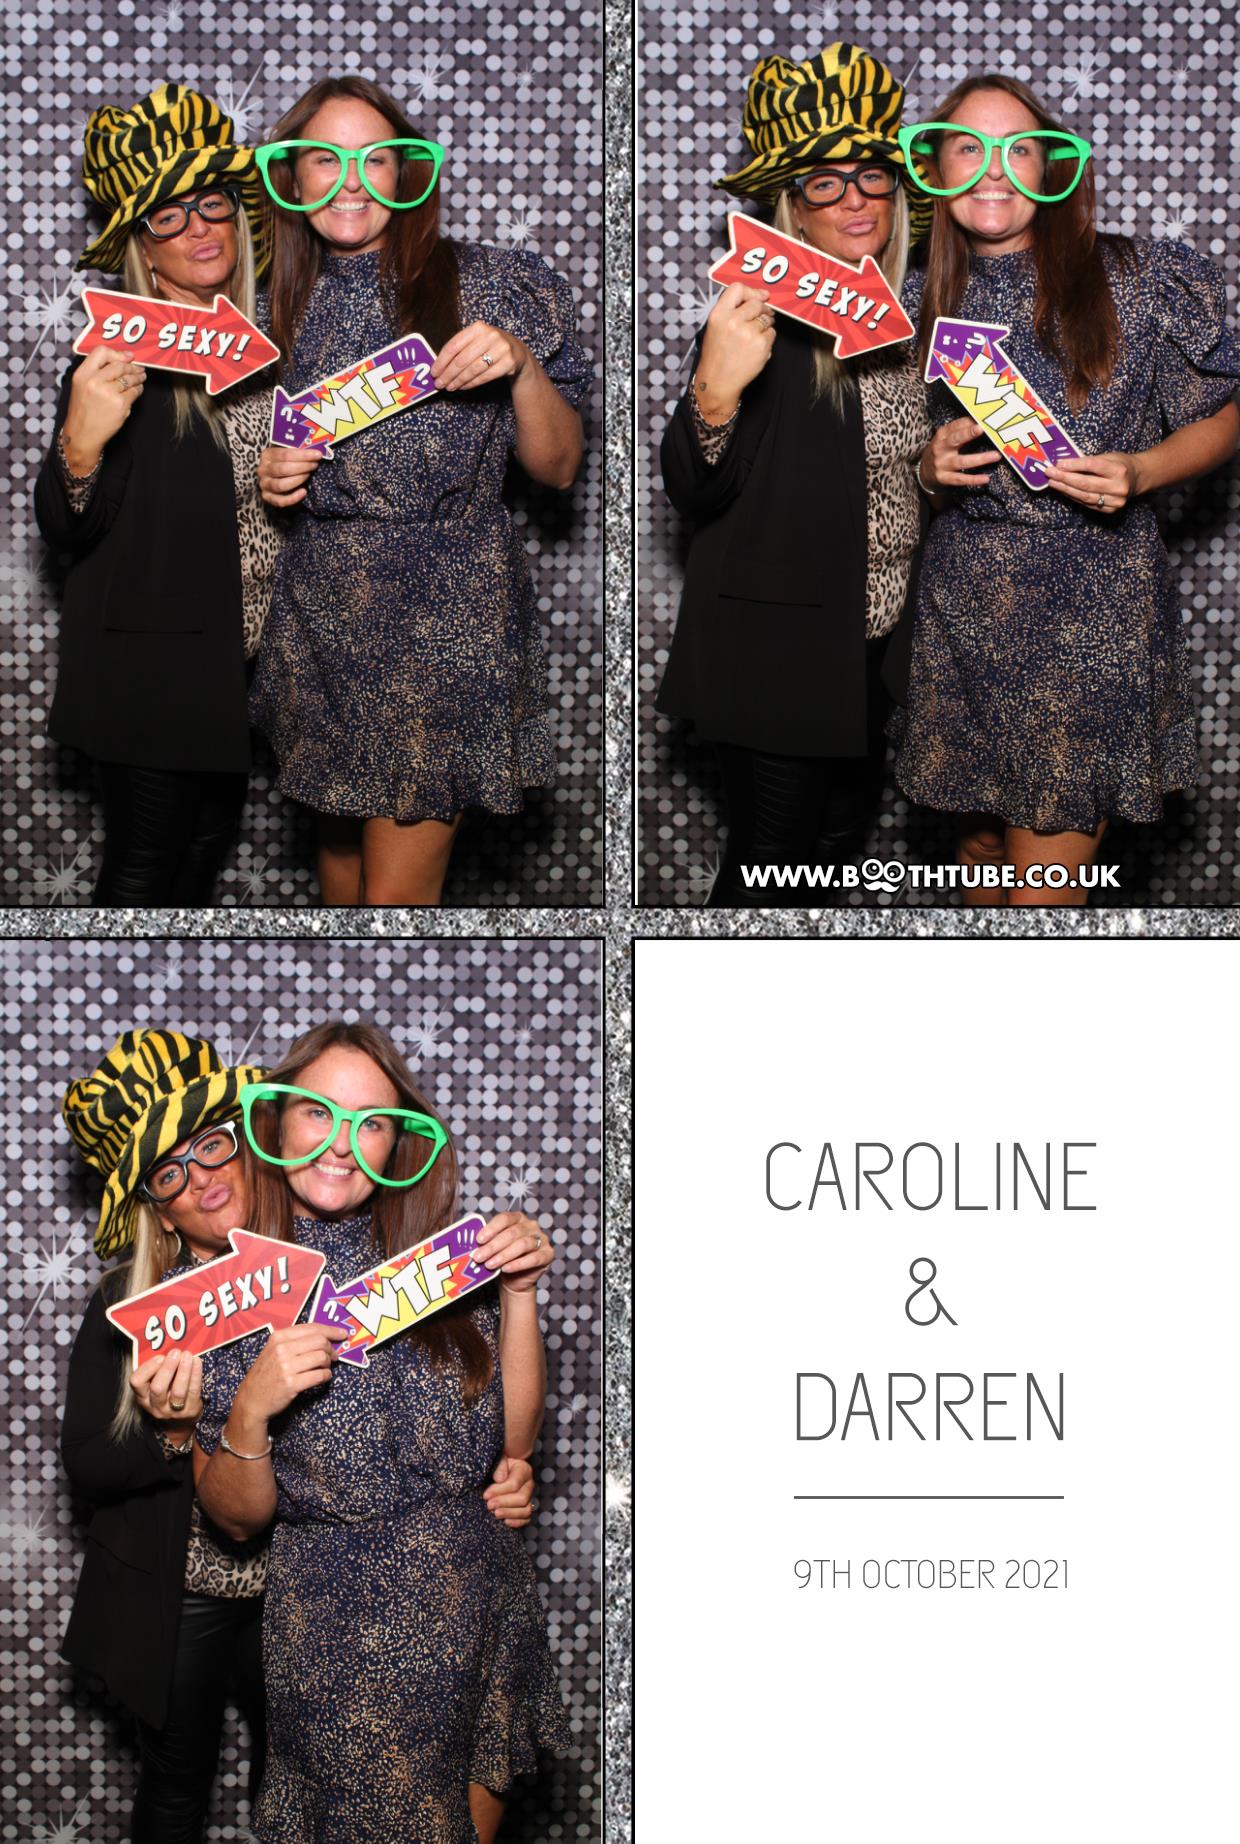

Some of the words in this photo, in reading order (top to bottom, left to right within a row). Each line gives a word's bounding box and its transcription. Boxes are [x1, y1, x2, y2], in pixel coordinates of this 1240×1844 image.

[740, 246, 789, 284] SO
[795, 272, 890, 330] SEXY!
[102, 313, 146, 343] SO
[158, 322, 251, 362] SEXY!
[301, 361, 401, 437] WTF
[955, 353, 1054, 448] WTF
[144, 1304, 187, 1352] SO
[198, 1256, 291, 1327] SEXY!
[344, 1245, 453, 1337] WTF
